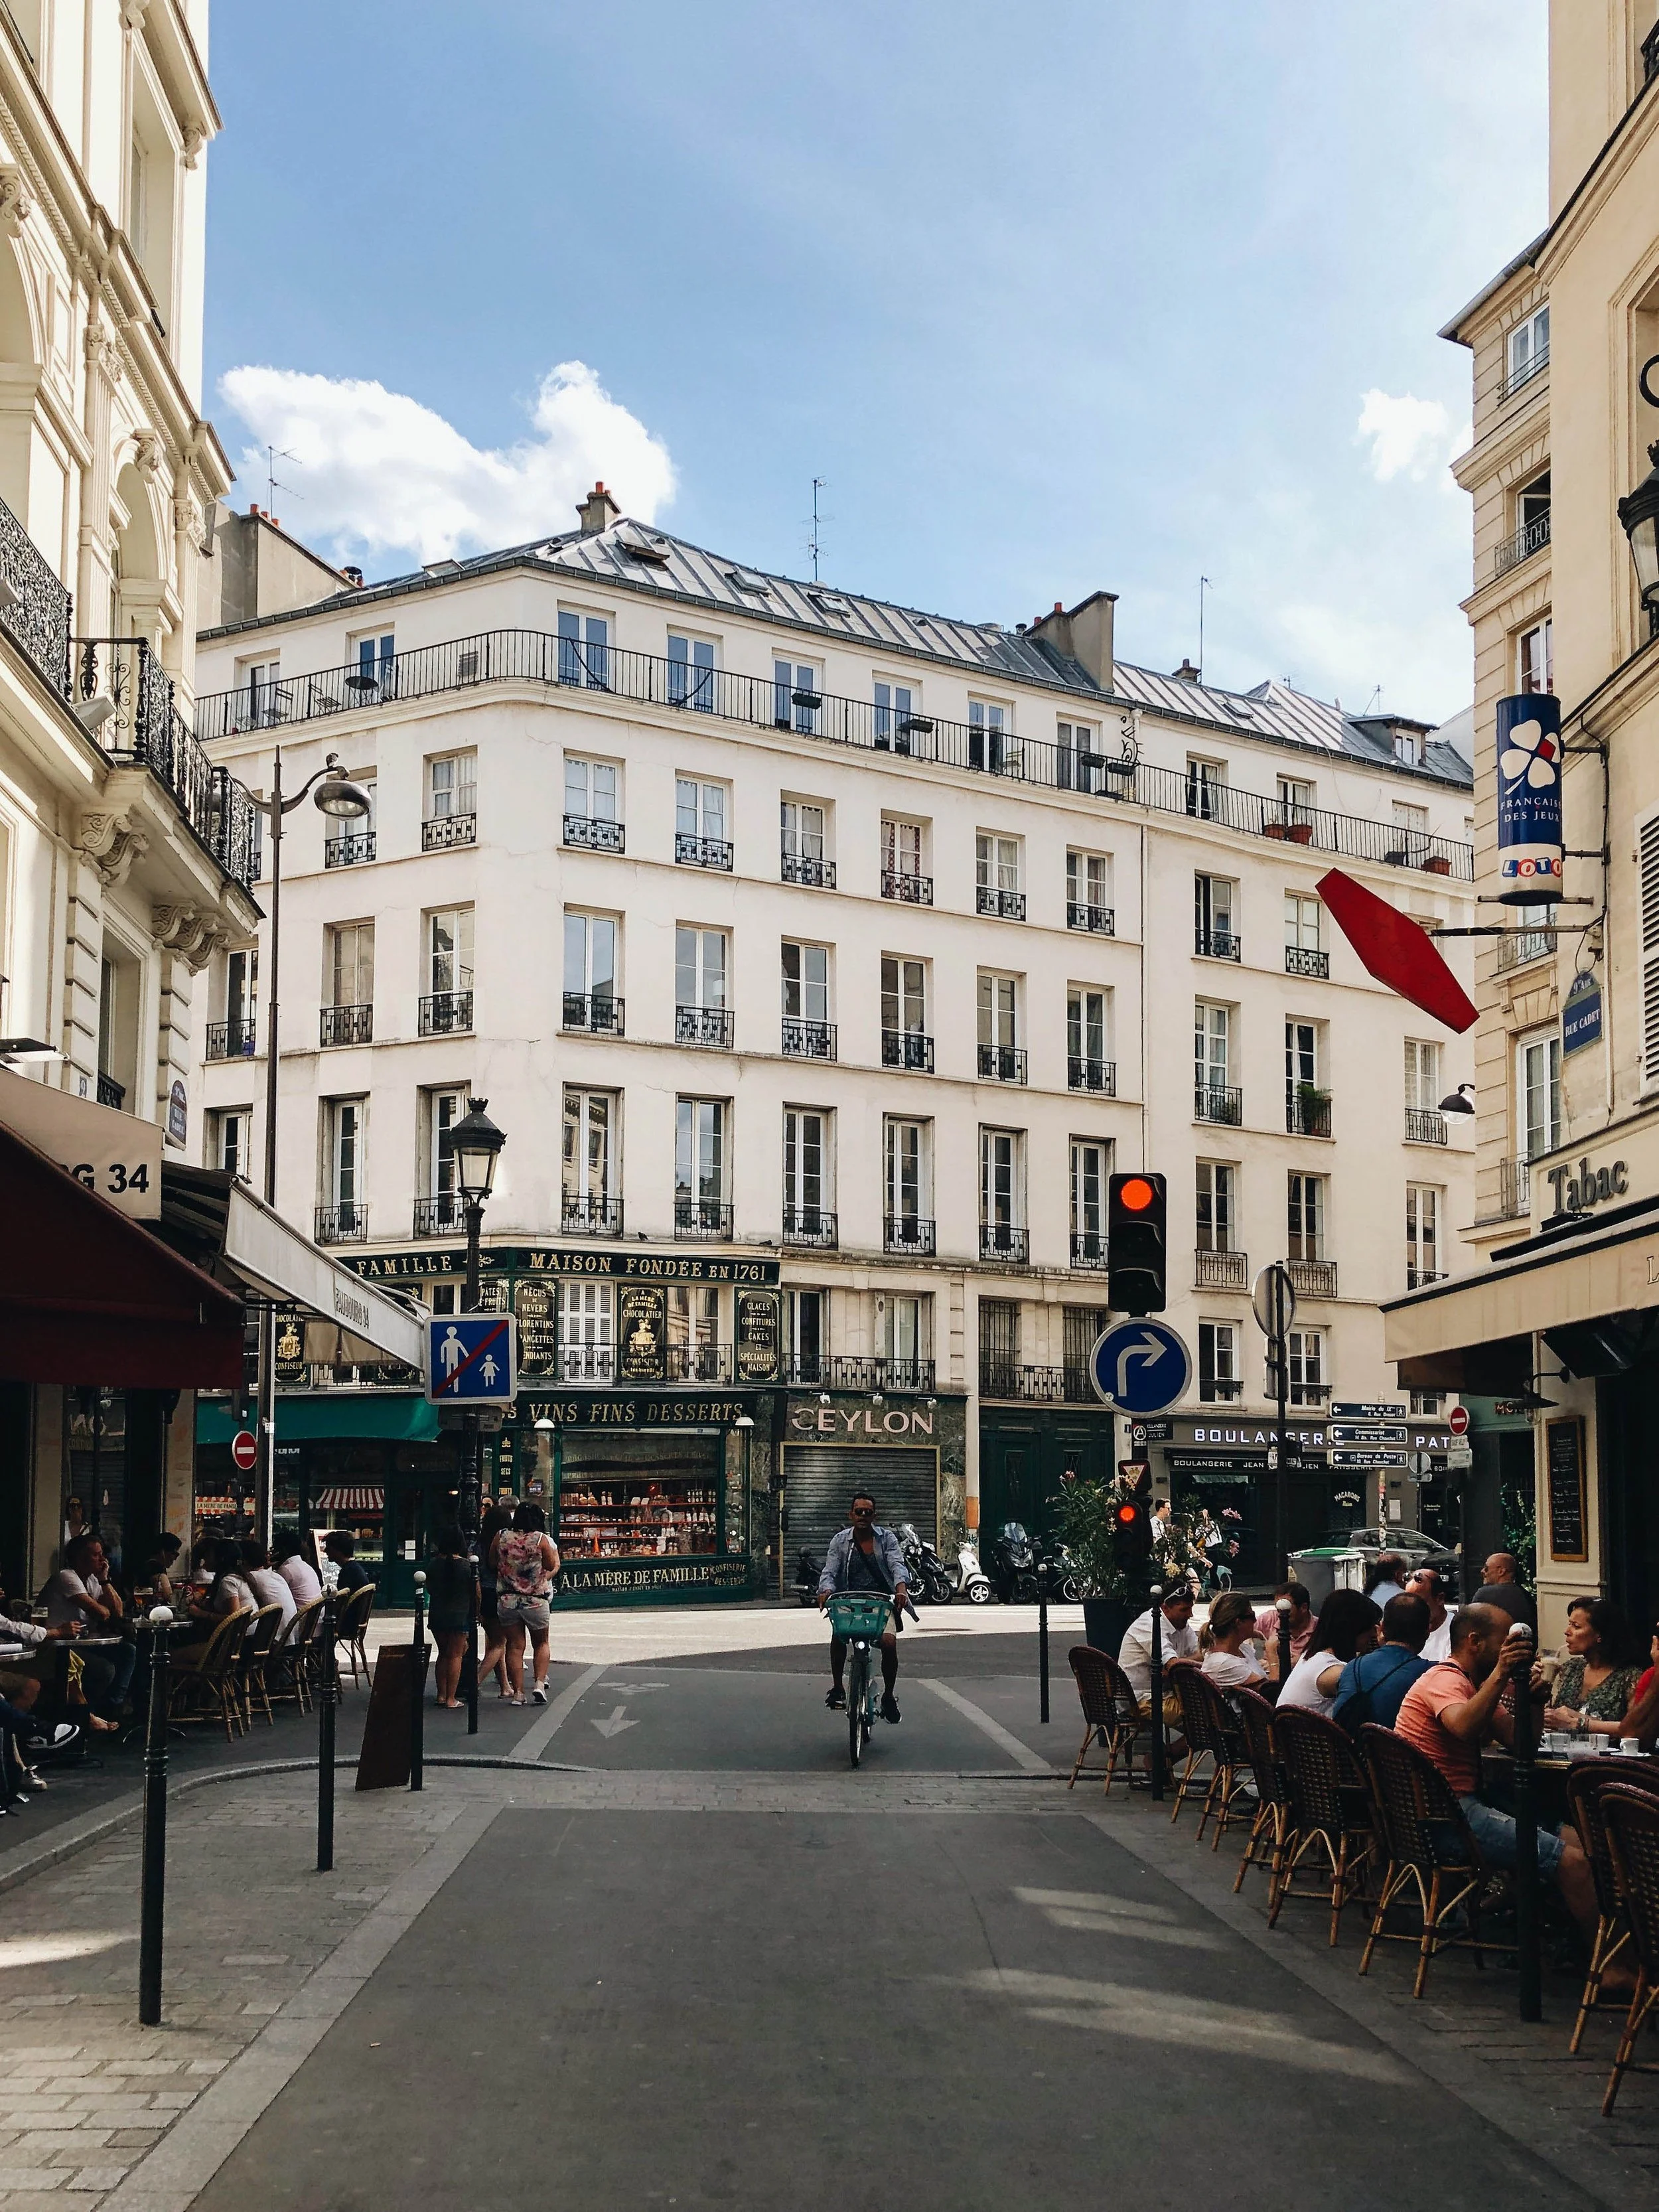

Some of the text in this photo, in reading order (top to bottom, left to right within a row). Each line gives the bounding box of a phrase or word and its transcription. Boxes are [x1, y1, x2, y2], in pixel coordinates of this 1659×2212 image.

[1500, 797, 1561, 810] FRANÇAIS
[1504, 811, 1559, 823] DES JEUX
[1502, 857, 1561, 877] LOTO
[1565, 1009, 1600, 1037] RUE CADET
[108, 1163, 149, 1193] 34
[1548, 1157, 1627, 1215] Tabac
[356, 1256, 452, 1276] FAMILLE
[530, 1253, 765, 1280] MAISON FONDÉE EN 1761
[522, 1303, 547, 1313] NEVERS
[747, 1302, 770, 1311] GLACES
[623, 1309, 662, 1319] CHOCOLATIER
[516, 1319, 554, 1328] FLORENTINS
[741, 1317, 776, 1326] CONFITURES
[520, 1335, 554, 1343] ANGETTES
[748, 1332, 769, 1341] CAKES
[530, 1403, 577, 1422] VINS
[589, 1403, 634, 1422] FINS
[647, 1403, 743, 1422] DESSERTS
[792, 1408, 933, 1434] CEYLON
[712, 1563, 747, 1574] CONFISERIE
[561, 1566, 710, 1588] À LA MÈRE DE FAMILLE
